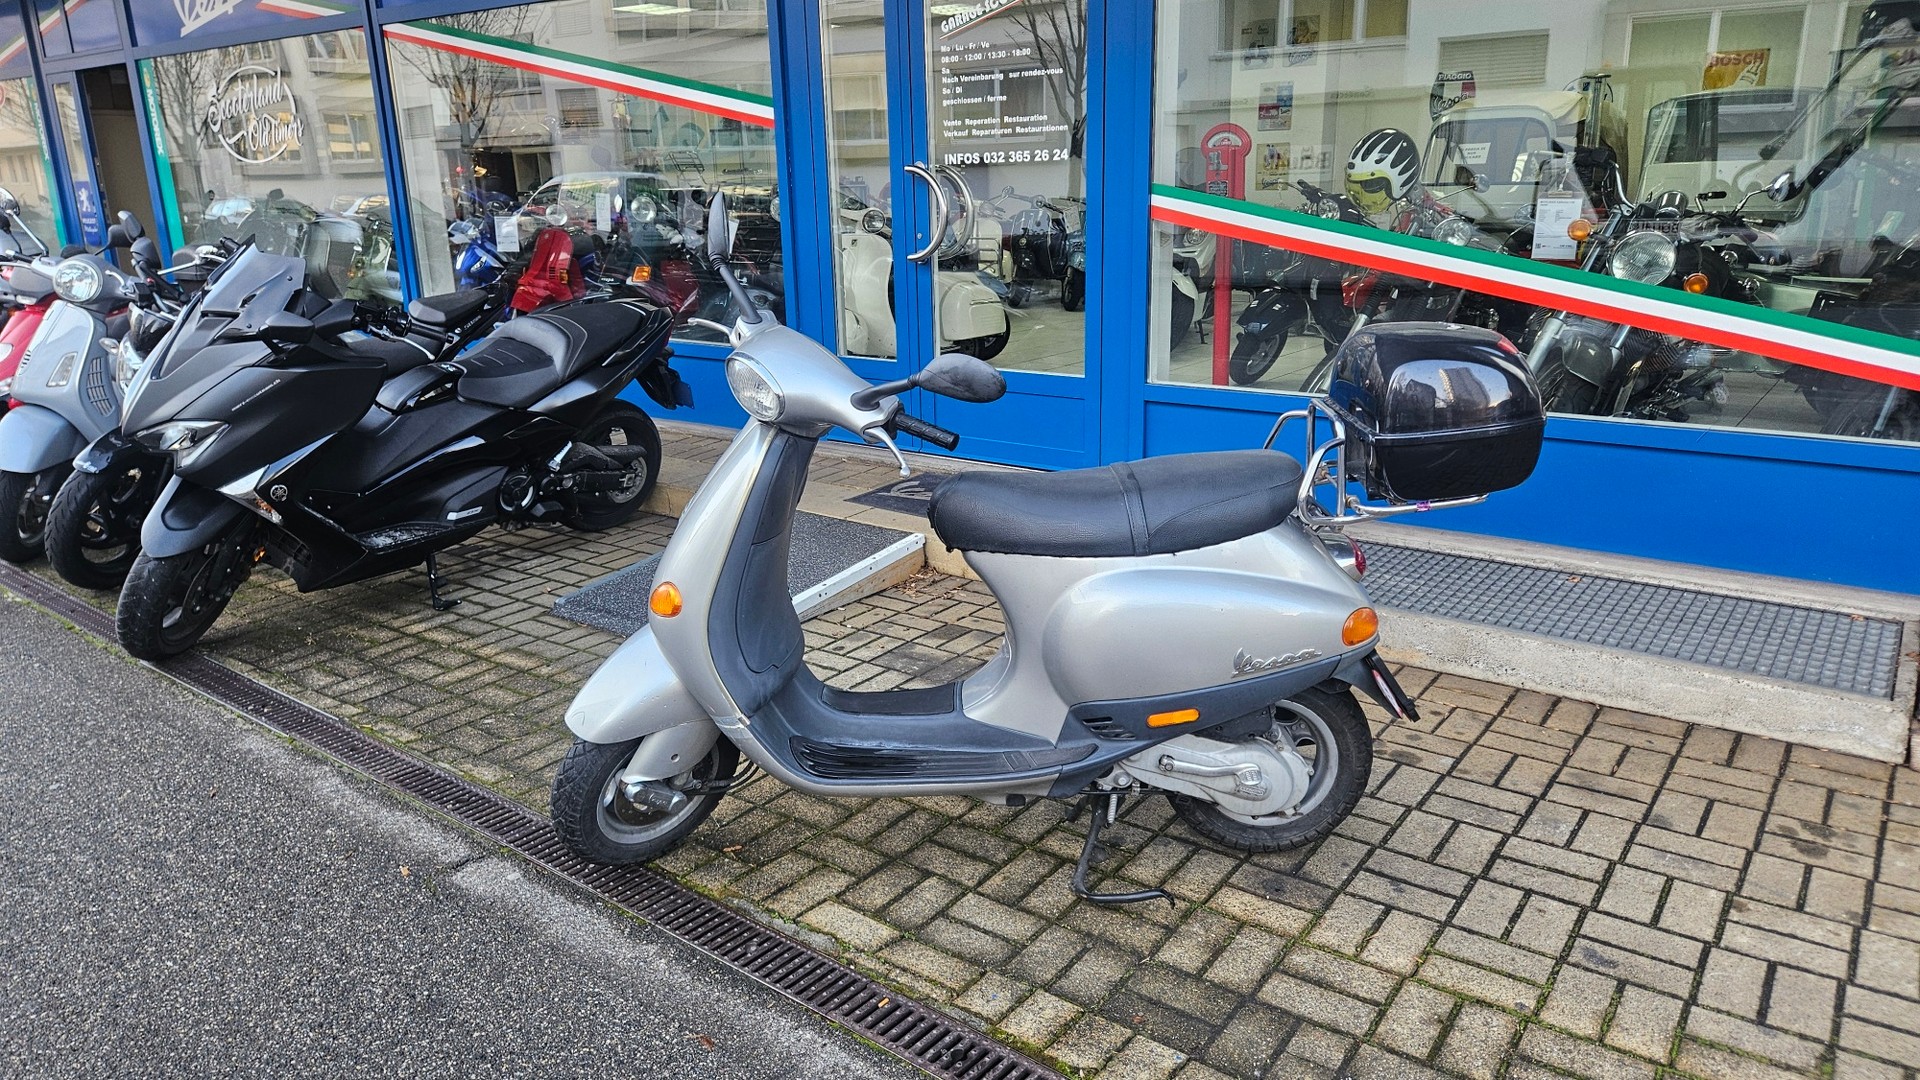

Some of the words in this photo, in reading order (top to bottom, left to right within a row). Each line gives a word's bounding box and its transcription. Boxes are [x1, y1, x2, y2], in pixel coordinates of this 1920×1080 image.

[940, 45, 952, 53] Mo
[955, 43, 964, 51] Lu
[980, 41, 990, 49] Ve
[941, 56, 959, 64] 08:00
[964, 53, 982, 61] 12:00
[988, 50, 1006, 59] 13:30
[1011, 48, 1031, 56] 18:00
[941, 67, 950, 75] Sa
[942, 75, 959, 84] Nach
[959, 72, 1004, 83] Vereinbarung
[1008, 71, 1020, 79] sur
[1021, 67, 1064, 78] rendez-vous
[1438, 72, 1472, 81] PIAGGIO
[942, 87, 951, 95] So
[207, 66, 284, 133] Scooterland
[942, 96, 983, 107] geschlossen
[146, 88, 165, 156] MOTOREX
[943, 119, 962, 128] Vente
[1003, 113, 1048, 123] Restauration
[943, 129, 969, 138] Verkauf
[971, 126, 1013, 137] Reparaturen
[1015, 124, 1069, 134] Restaurationen
[944, 152, 980, 165] INFOS
[983, 151, 1006, 164] 032
[1008, 149, 1031, 163] 365
[1034, 148, 1050, 162] 26
[1052, 147, 1069, 161] 24
[1231, 647, 1322, 679] Vespa
